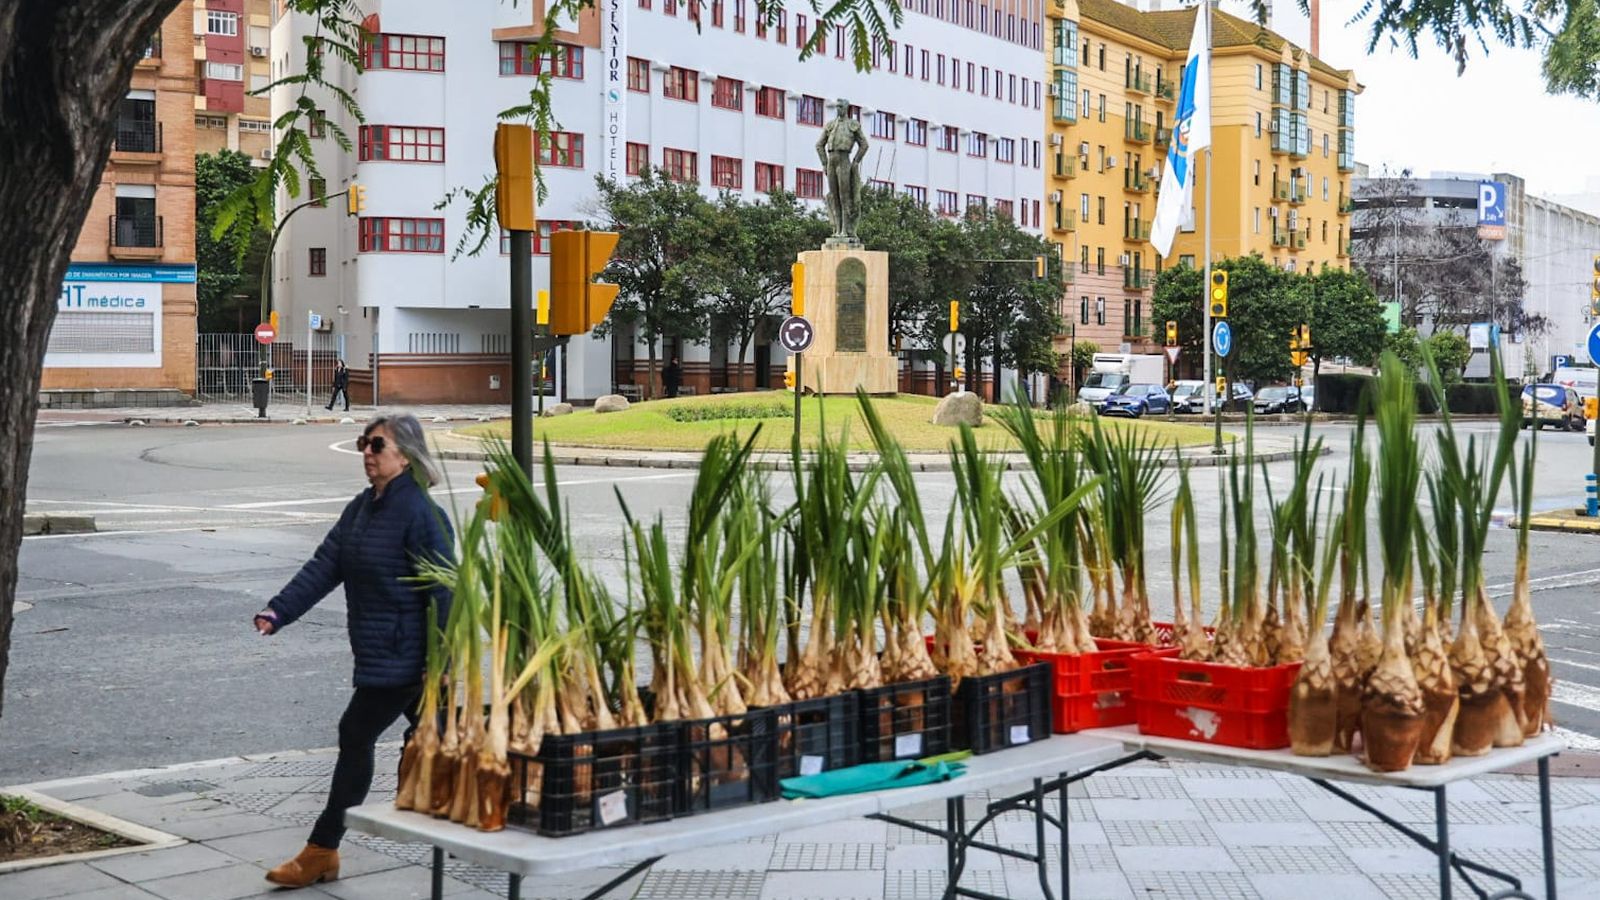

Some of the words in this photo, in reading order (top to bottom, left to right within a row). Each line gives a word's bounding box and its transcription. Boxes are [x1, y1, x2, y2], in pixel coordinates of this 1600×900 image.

[609, 0, 619, 81] SENATOR
[609, 112, 618, 182] HOTELS
[1480, 184, 1497, 220] P
[88, 296, 145, 307] médica
[1556, 357, 1565, 368] P
